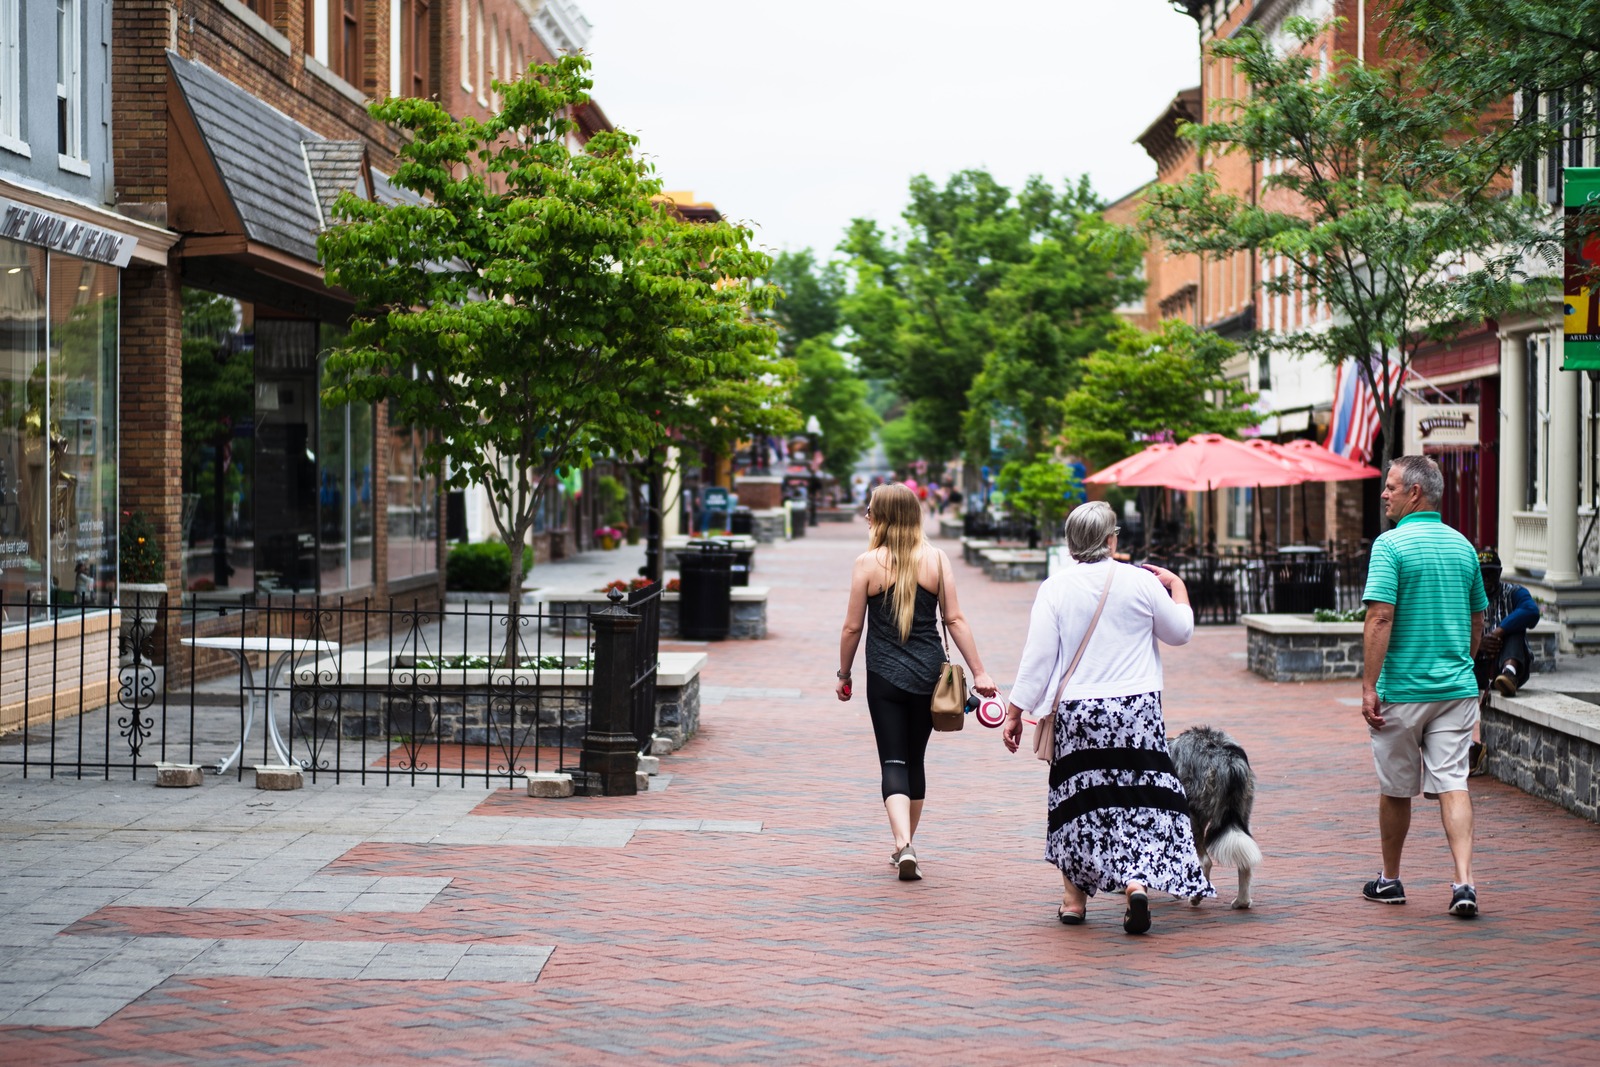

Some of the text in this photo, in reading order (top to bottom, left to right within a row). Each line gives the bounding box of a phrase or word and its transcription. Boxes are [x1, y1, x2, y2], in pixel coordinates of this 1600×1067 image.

[3, 206, 124, 262] THE WORLD OF HEALING
[6, 541, 15, 553] heart
[17, 540, 28, 555] gallery
